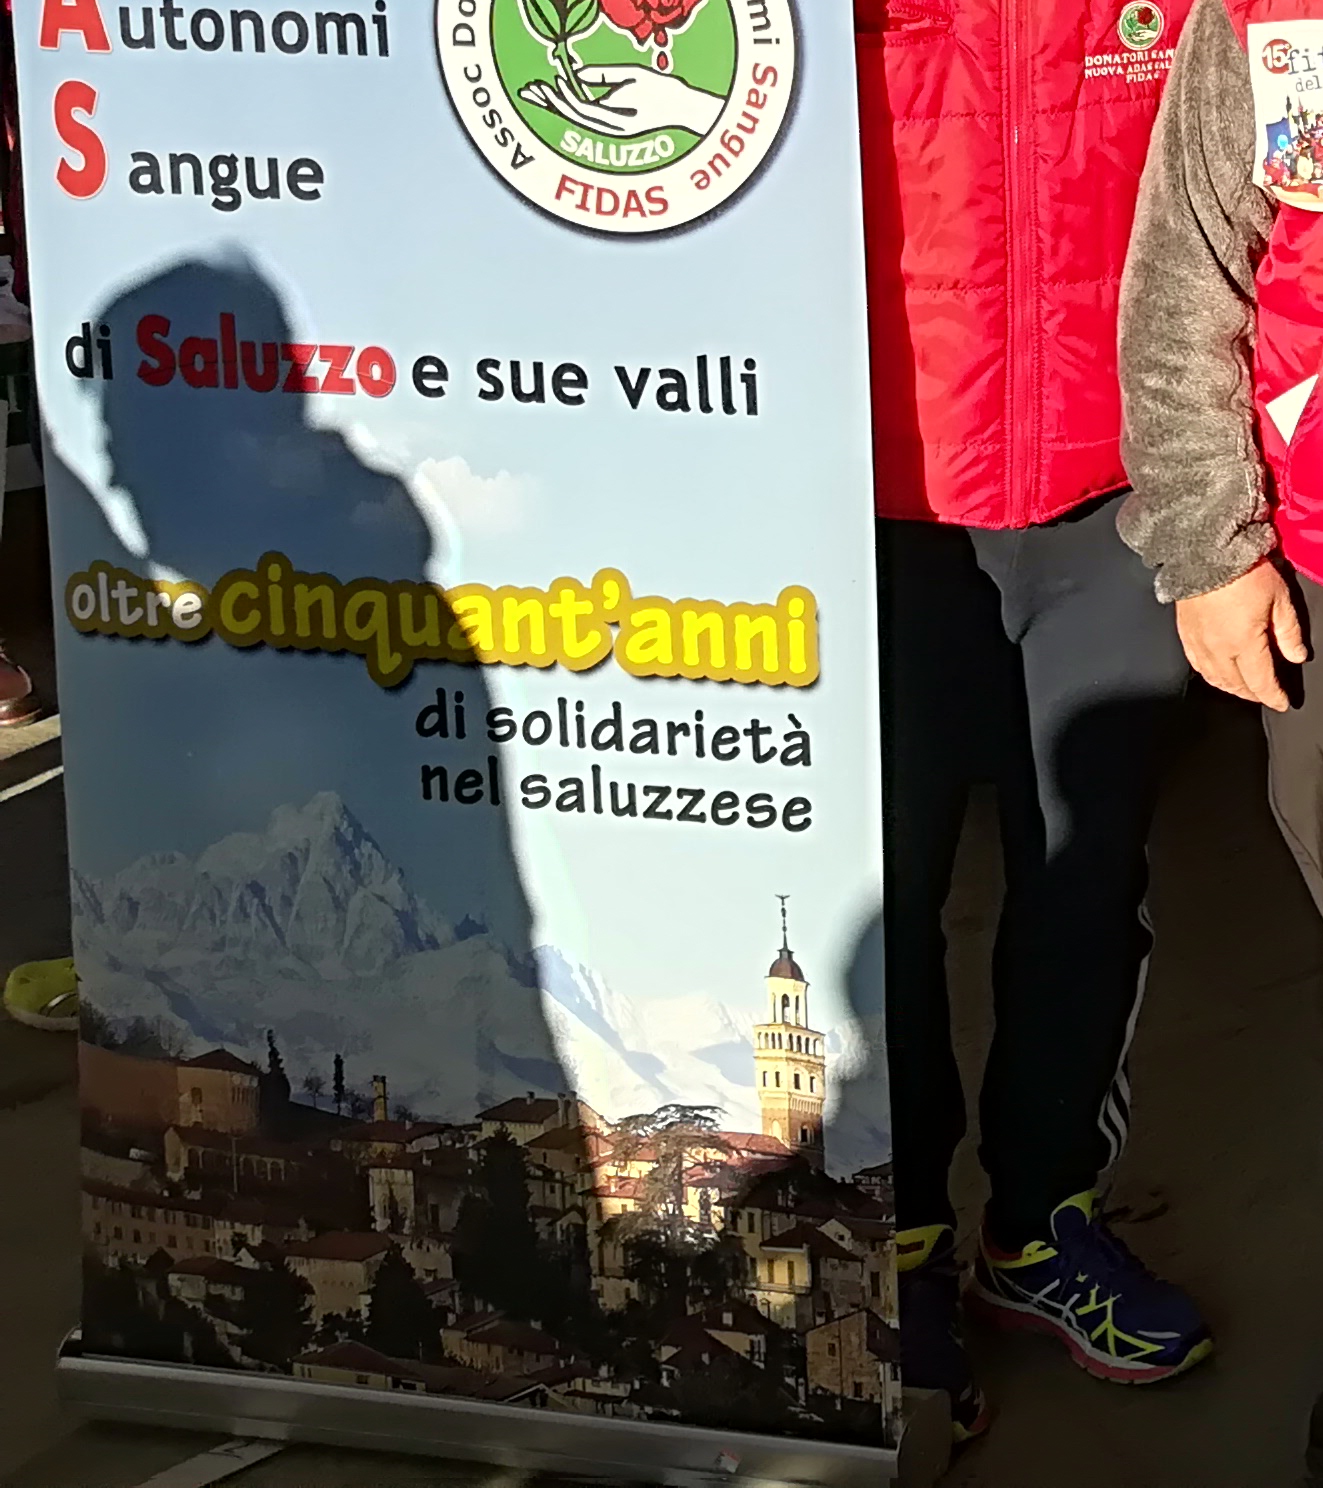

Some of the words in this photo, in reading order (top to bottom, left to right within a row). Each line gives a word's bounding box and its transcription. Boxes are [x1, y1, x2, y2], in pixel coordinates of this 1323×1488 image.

[1085, 51, 1149, 68] DONATORI
[1085, 64, 1124, 79] NUOVA
[1126, 63, 1153, 75] ADAS
[1295, 75, 1323, 93] del
[470, 63, 536, 168] Assoc
[688, 62, 779, 193] Sangue
[559, 127, 676, 167] SALUZZO
[554, 173, 670, 219] FIDAS
[65, 321, 113, 382] di
[135, 311, 398, 399] Saluzzo
[411, 355, 449, 399] e
[478, 357, 589, 407] sue
[615, 353, 760, 418] valli
[72, 571, 204, 631] oltre
[219, 563, 808, 675] cinquant'anni
[415, 687, 468, 742] di
[486, 696, 813, 768] solidarietà
[420, 757, 501, 808] nel
[520, 763, 814, 832] saluzzese
